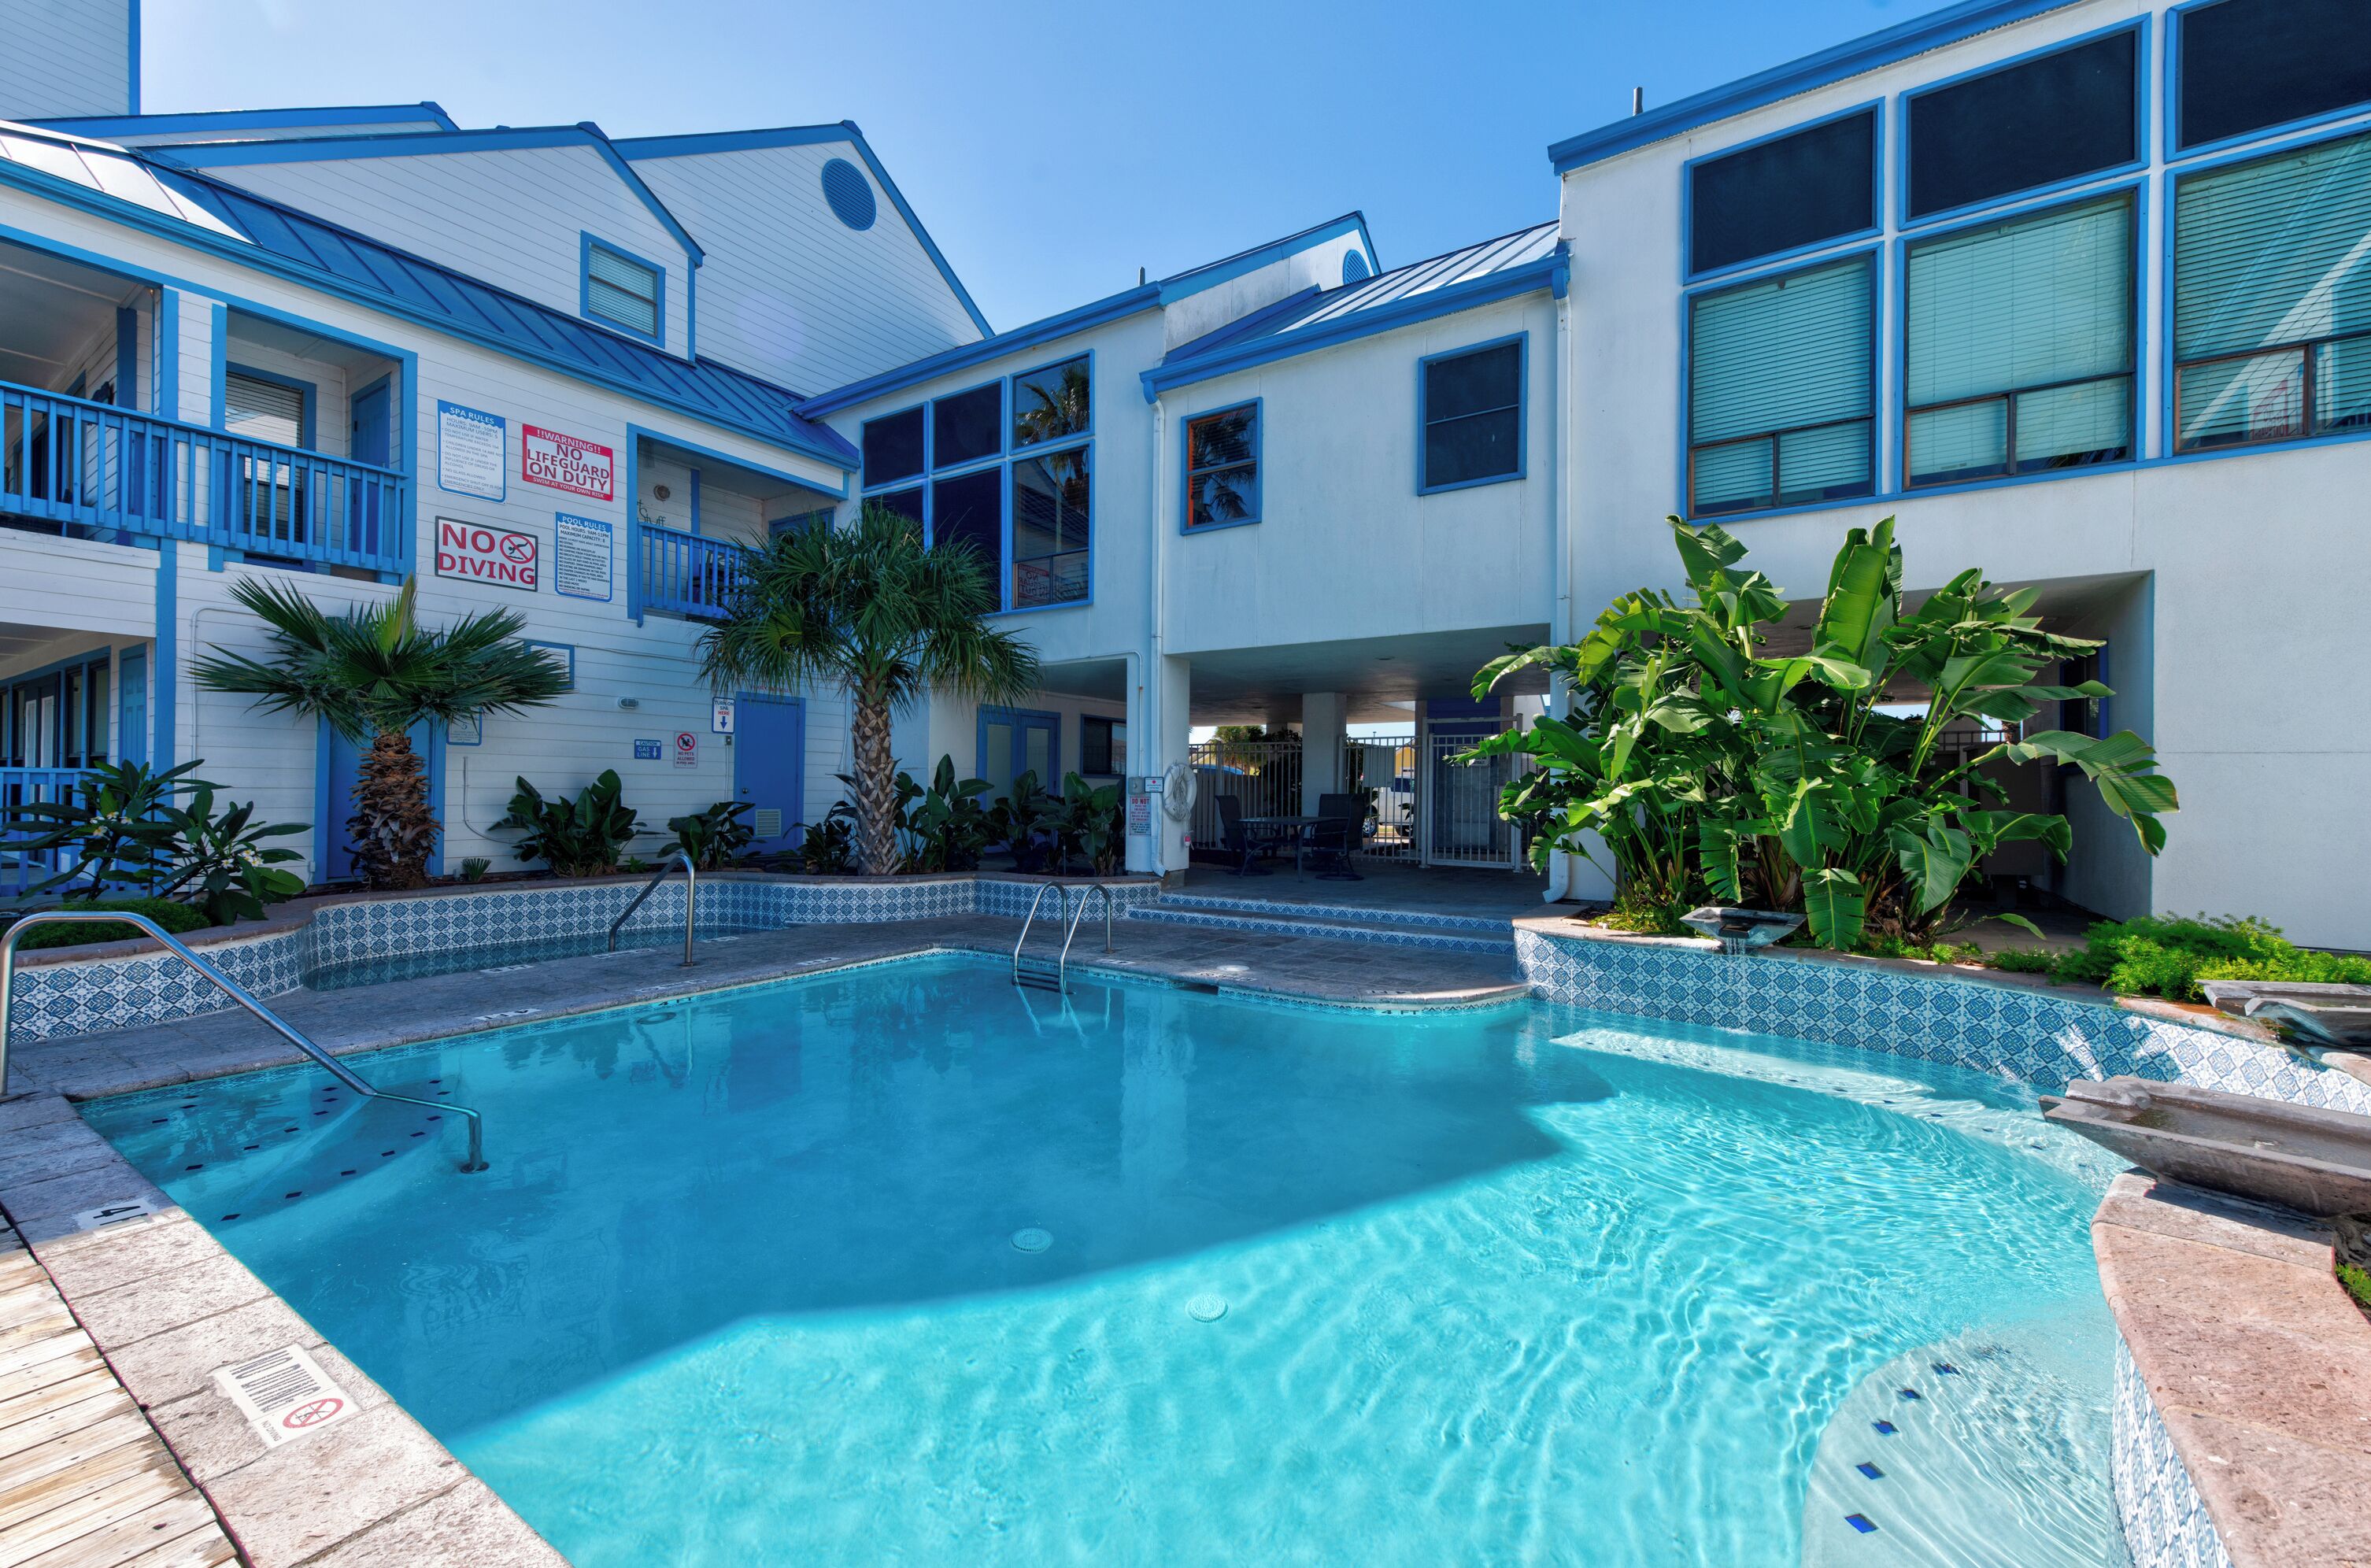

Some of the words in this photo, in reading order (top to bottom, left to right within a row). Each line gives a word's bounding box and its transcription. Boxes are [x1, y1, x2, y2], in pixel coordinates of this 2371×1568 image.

[447, 417, 467, 426] HOURS:
[450, 407, 466, 417] SPA
[469, 412, 494, 424] RULES
[447, 422, 474, 433] MAXIMUM
[446, 440, 466, 448] CHILDREN
[537, 429, 601, 454] !!WARNING!!
[557, 443, 583, 461] NO
[527, 448, 610, 479] LIFEGUARD
[529, 462, 557, 479] ON
[563, 470, 607, 491] DUTY
[533, 477, 551, 486] SWIM
[560, 483, 577, 492] YOUR
[442, 523, 496, 554] NO
[438, 552, 535, 584] DIVING
[93, 1206, 141, 1219] 4
[261, 1420, 271, 1428] NO
[265, 1426, 282, 1442] DIVING
